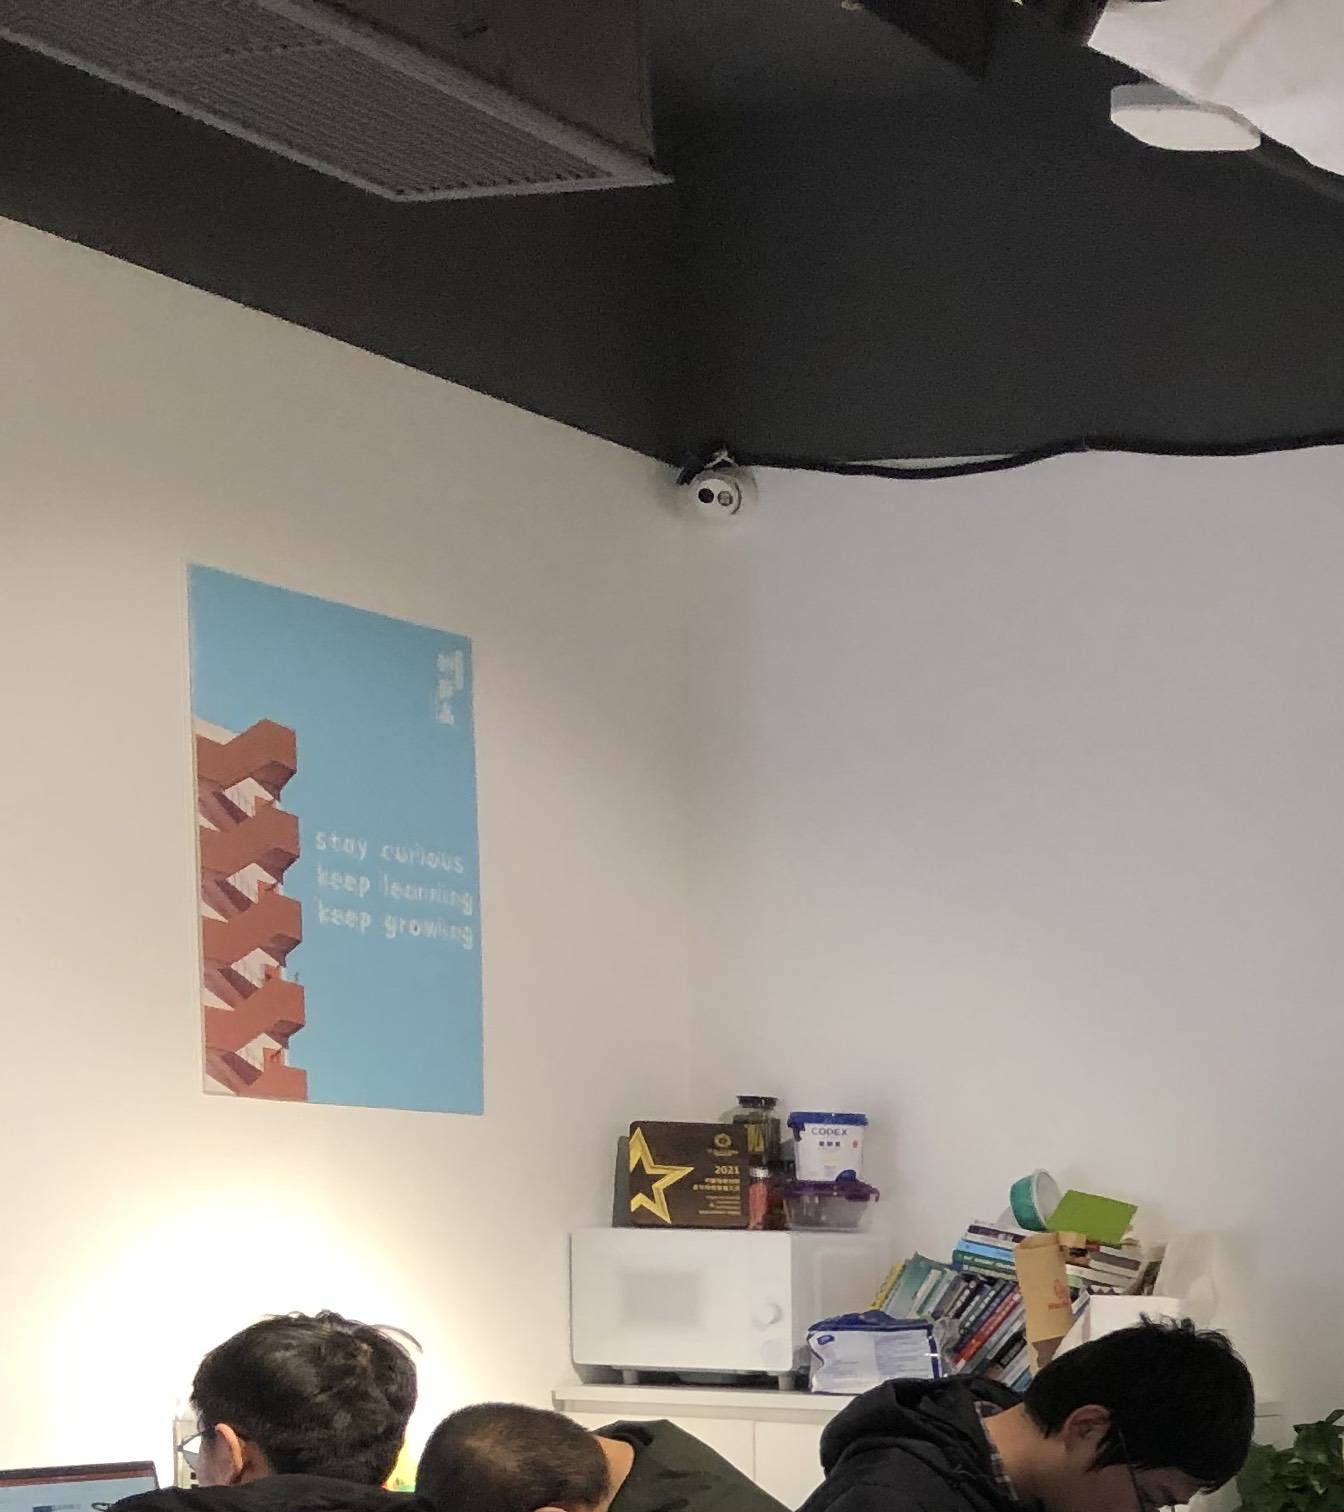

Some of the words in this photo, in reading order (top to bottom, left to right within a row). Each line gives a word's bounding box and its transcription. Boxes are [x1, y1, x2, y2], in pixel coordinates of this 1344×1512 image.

[316, 832, 368, 860] stay
[382, 843, 464, 874] curious
[316, 864, 370, 898] keep
[384, 873, 473, 916] learning
[318, 899, 371, 935] keep
[384, 914, 473, 949] growing
[811, 1128, 847, 1136] CODEX
[714, 1166, 740, 1175] 2021
